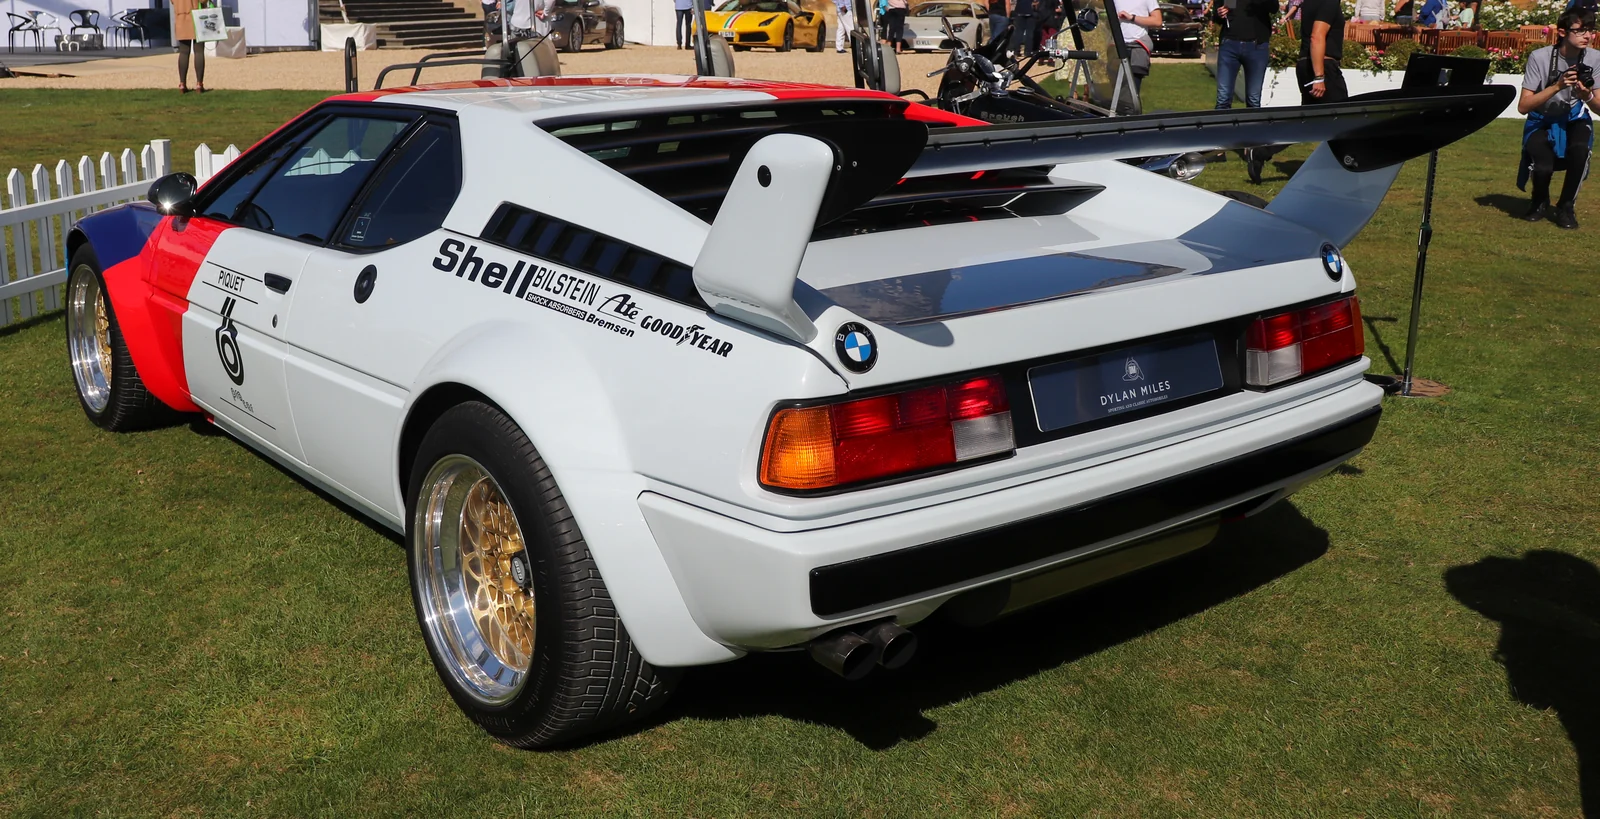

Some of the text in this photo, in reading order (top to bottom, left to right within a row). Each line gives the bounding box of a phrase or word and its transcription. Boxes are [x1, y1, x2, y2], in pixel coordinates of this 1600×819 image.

[217, 270, 246, 292] PIQUET
[432, 238, 539, 299] Shell
[532, 267, 601, 306] BILSTEIN
[527, 293, 586, 319] SHOCK ABSORBERS
[597, 294, 641, 320] Ate
[586, 313, 635, 338] Bremsen
[640, 315, 734, 358] GOODYEAR
[836, 324, 871, 342] BMW
[1100, 380, 1171, 406] DYLAN MILES
